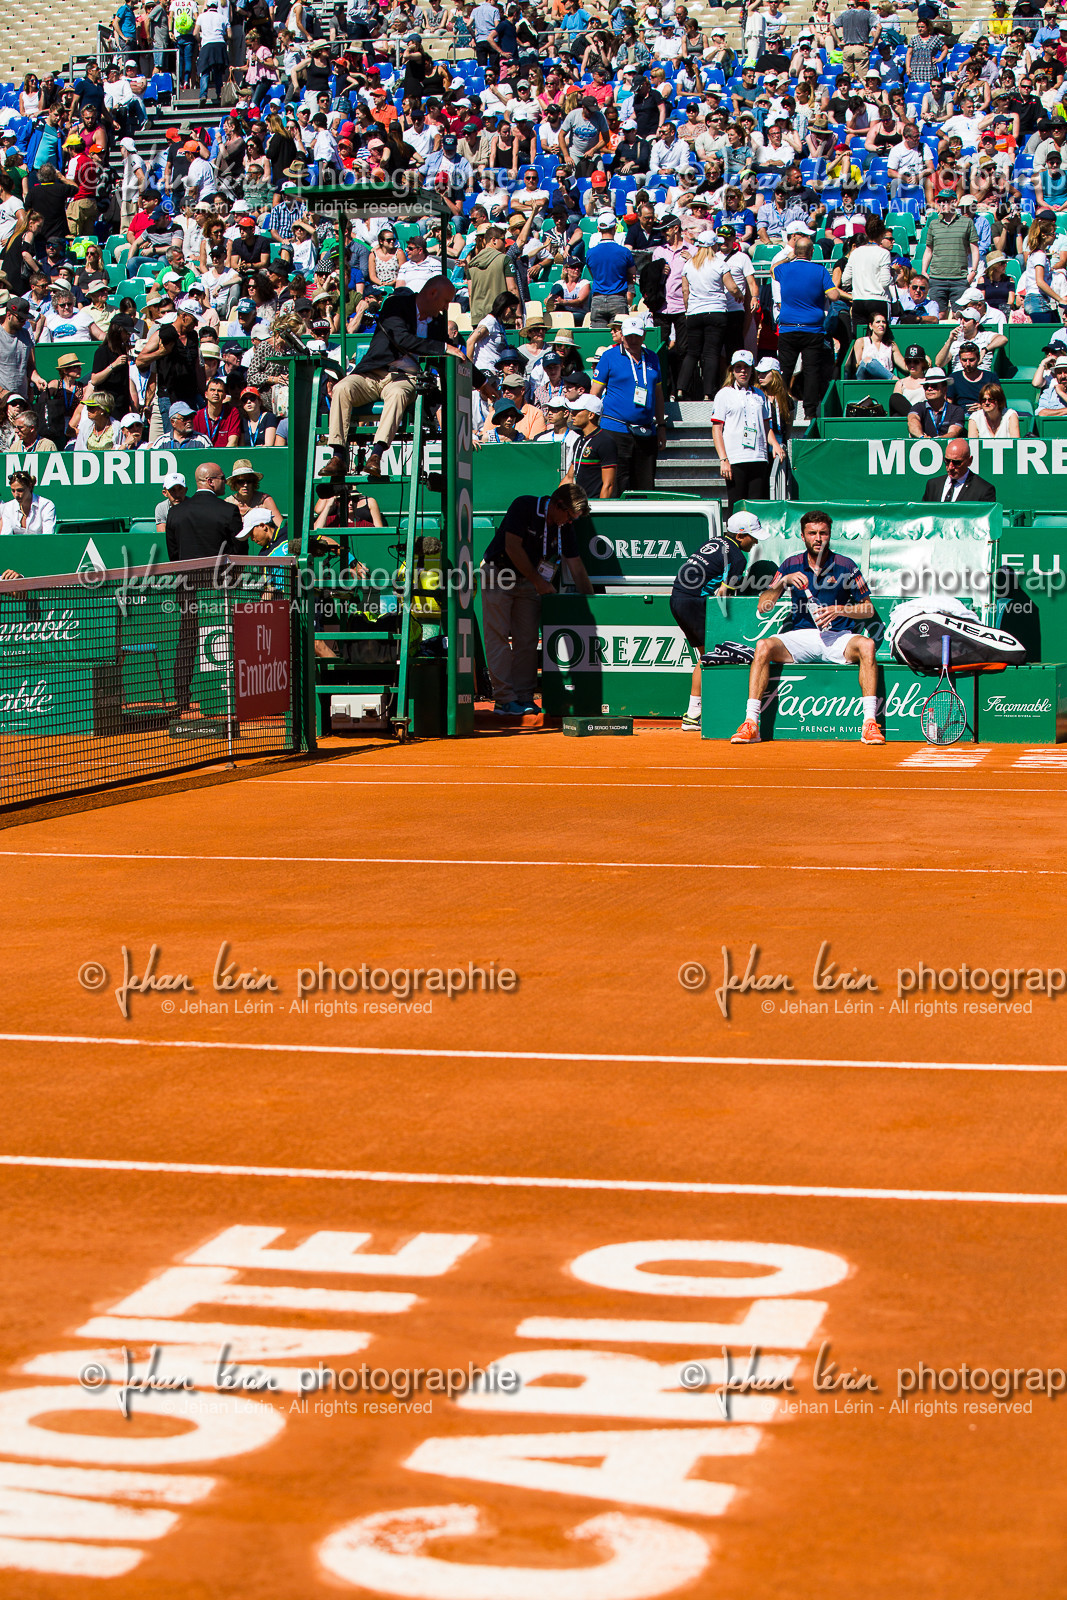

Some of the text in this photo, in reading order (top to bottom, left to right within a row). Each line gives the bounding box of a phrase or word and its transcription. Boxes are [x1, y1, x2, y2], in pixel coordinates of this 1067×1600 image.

[5, 450, 178, 487] MADRID
[256, 624, 271, 655] Fly
[944, 617, 1017, 646] HEAD
[546, 628, 700, 668] OREZZA
[238, 658, 288, 698] Emirates
[982, 695, 1053, 714] Façonnable
[800, 725, 862, 733] FRENCH RIVIE
